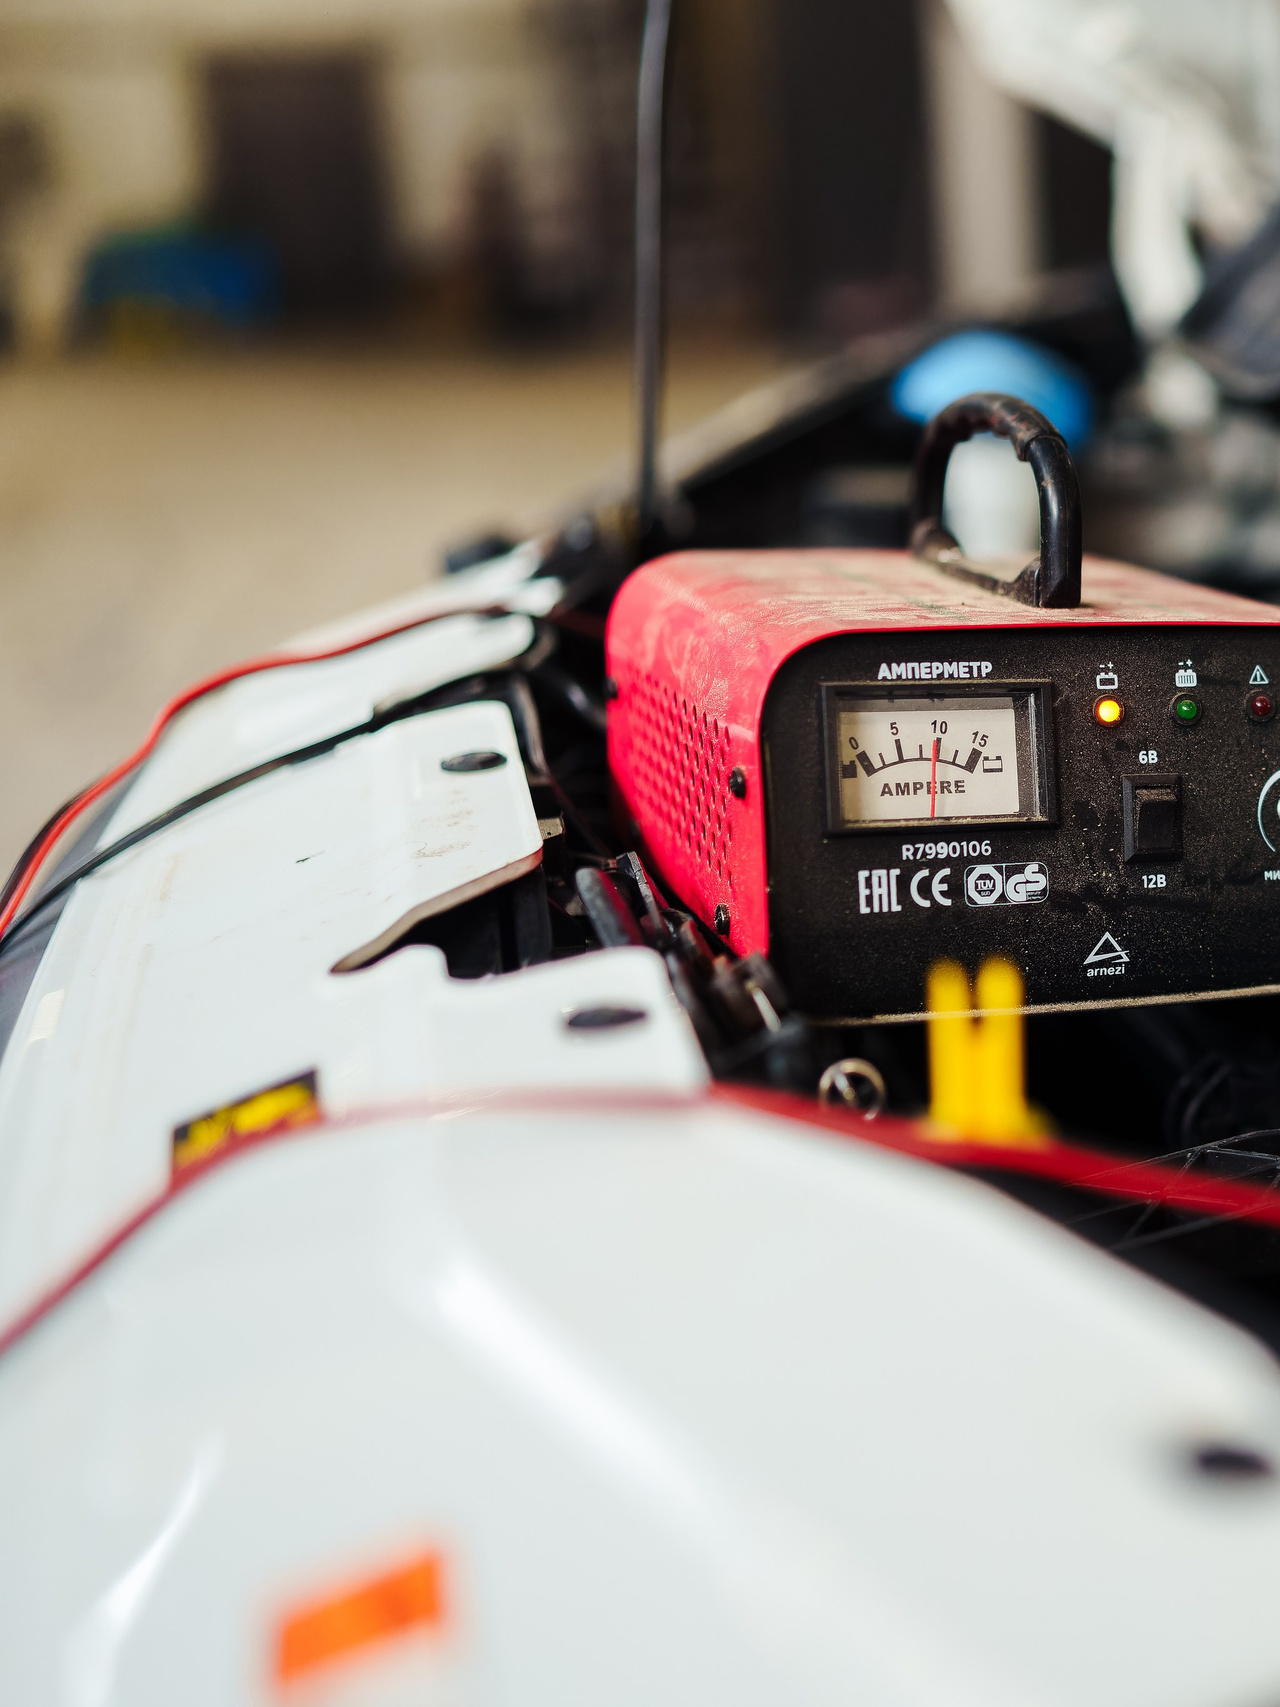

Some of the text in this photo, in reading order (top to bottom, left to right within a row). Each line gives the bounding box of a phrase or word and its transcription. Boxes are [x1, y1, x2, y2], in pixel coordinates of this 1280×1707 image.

[877, 661, 993, 680] АМПЕРМЕТР
[848, 719, 990, 751] 0 5 10 15
[880, 779, 966, 798] AMPERE
[901, 840, 992, 861] R7990106
[909, 867, 952, 908] CE
[1086, 963, 1126, 978] arnezi
